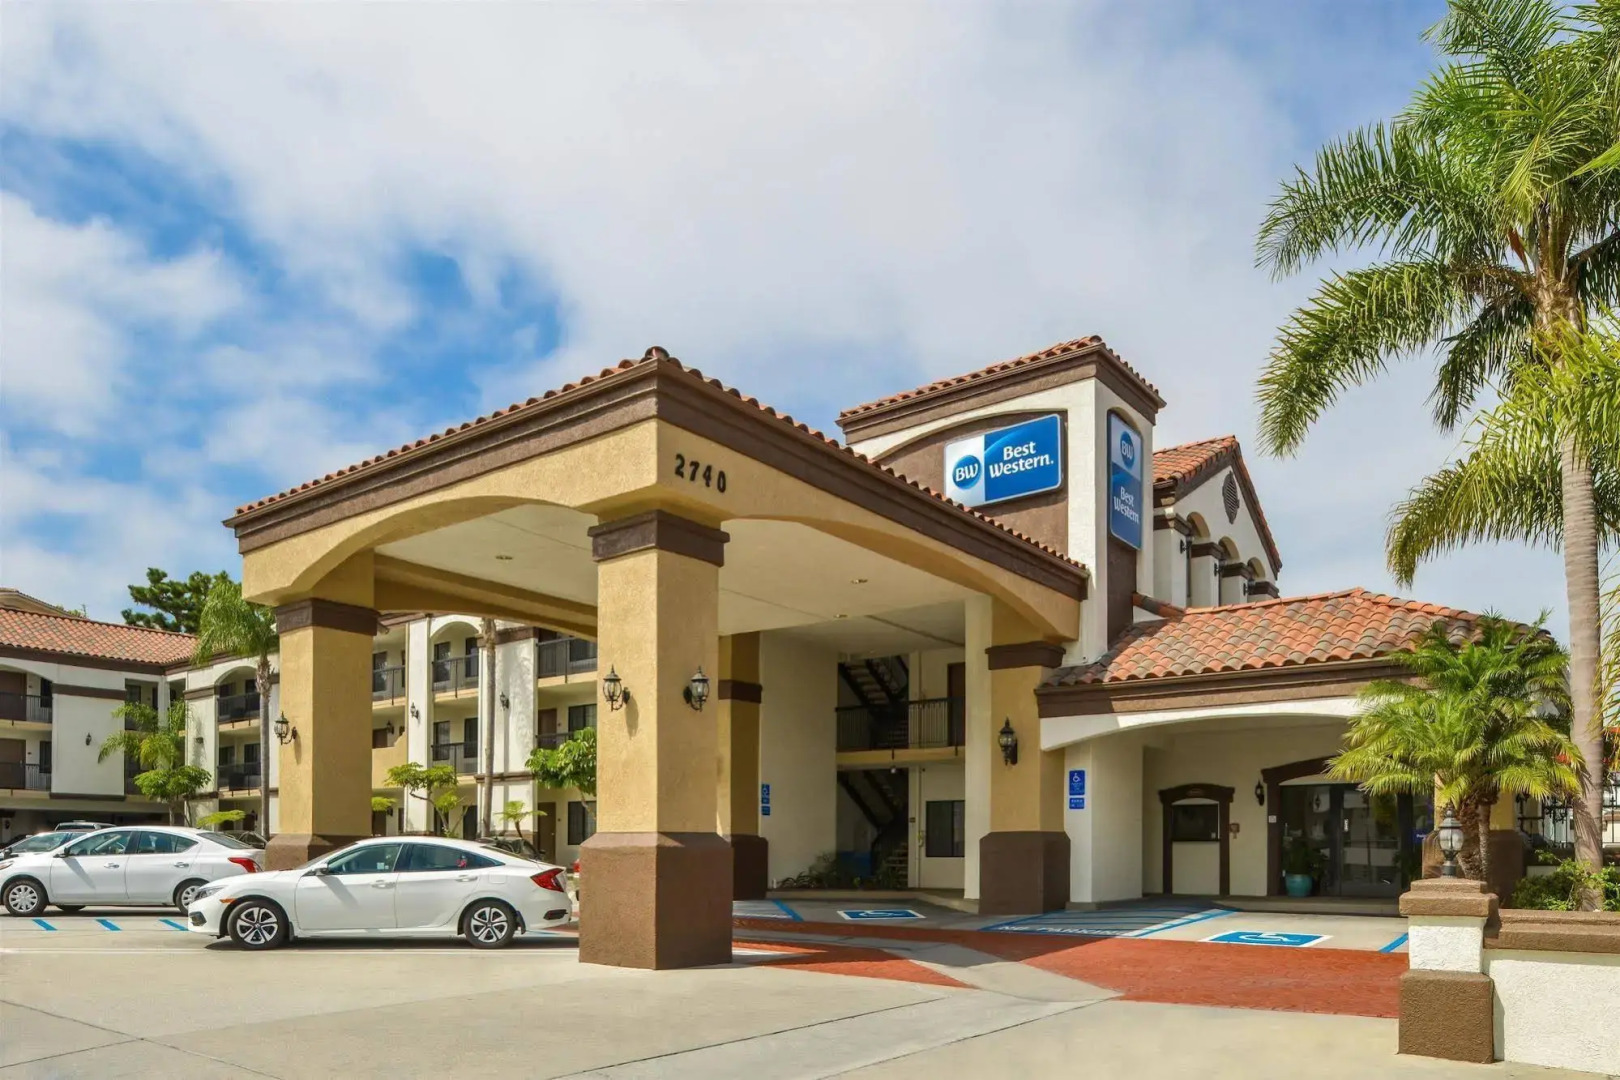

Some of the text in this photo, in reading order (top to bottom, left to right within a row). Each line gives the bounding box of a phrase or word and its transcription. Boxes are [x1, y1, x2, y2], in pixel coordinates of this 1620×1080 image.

[1003, 441, 1036, 461] Best
[1121, 440, 1134, 460] BW
[674, 453, 726, 493] 2740
[955, 463, 978, 482] BW
[1120, 486, 1134, 507] Best
